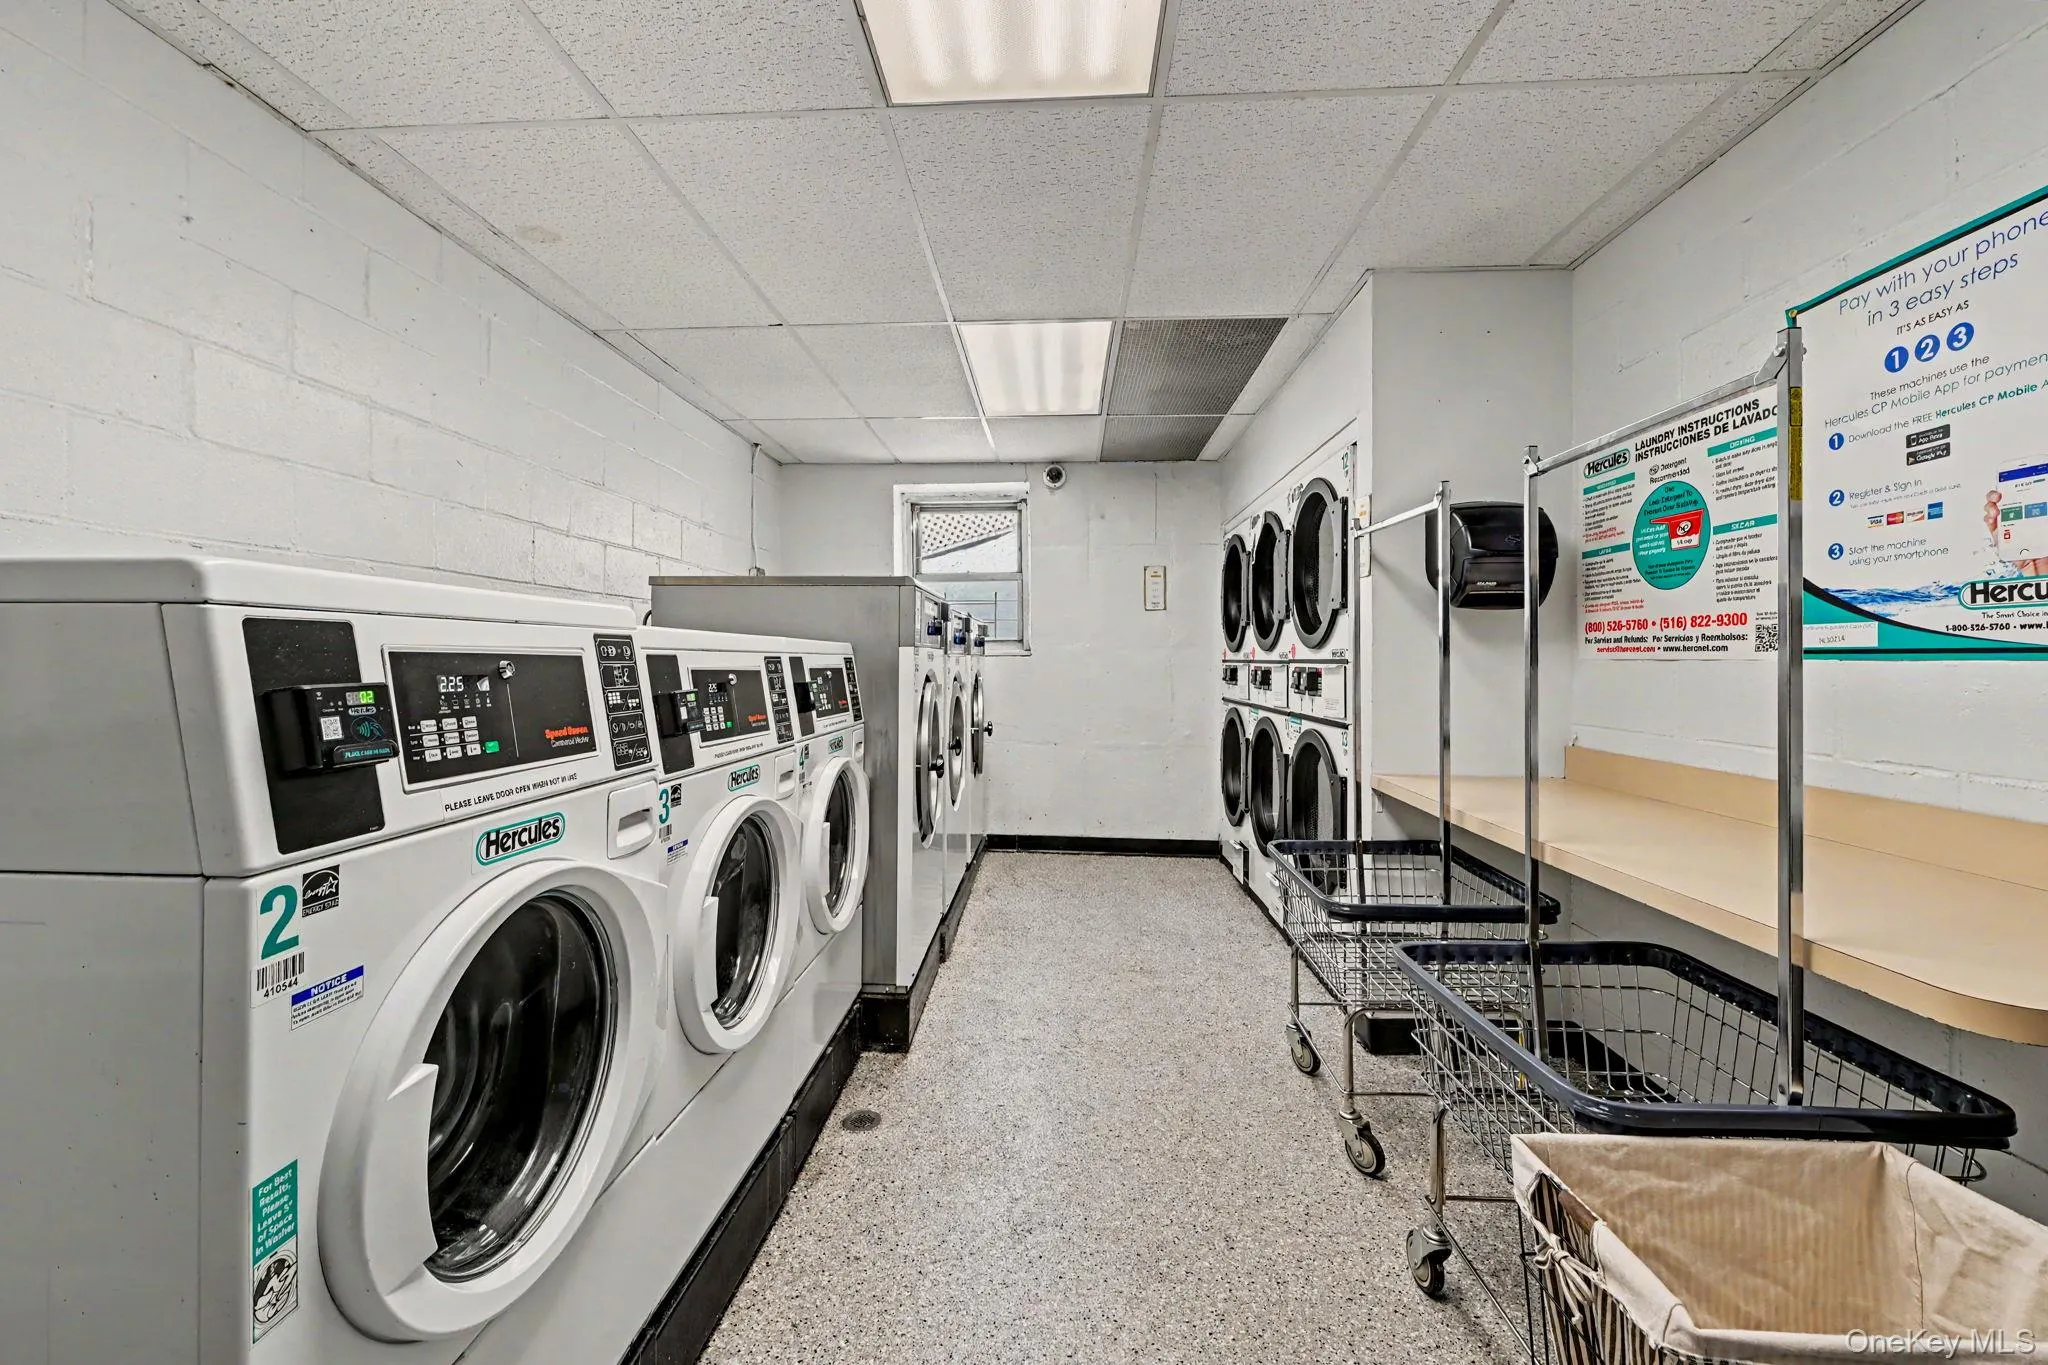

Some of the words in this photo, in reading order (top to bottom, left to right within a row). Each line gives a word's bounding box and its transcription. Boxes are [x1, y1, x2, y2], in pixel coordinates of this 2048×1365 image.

[1839, 291, 1871, 315] Pay
[1876, 271, 1916, 298] with
[1922, 247, 1968, 283] your
[1976, 210, 2048, 261] phone
[1867, 310, 1883, 326] in
[1889, 300, 1900, 318] 3
[1906, 280, 1954, 310] easy
[1960, 253, 2018, 289] steps
[1896, 323, 1912, 336] IT'S
[1913, 317, 1926, 329] AS
[1928, 305, 1954, 323] EASY
[1955, 300, 1970, 313] AS
[1891, 351, 1900, 369] 1
[1920, 339, 1934, 360] 2
[1953, 326, 1967, 348] 3
[1870, 385, 1897, 401] These
[1899, 369, 1948, 391] machines
[1949, 363, 1968, 375] use
[1971, 355, 1990, 369] the
[1824, 406, 1869, 429] Hercules
[1871, 401, 1888, 416] CP
[1890, 386, 1931, 409] Mobile
[1934, 378, 1960, 397] App
[1963, 372, 1981, 387] for
[1634, 429, 1675, 452] LAUNDRY
[1677, 399, 1760, 435] INSTRUCTIONS
[1848, 424, 1892, 444] Download
[1894, 418, 1909, 430] the
[1911, 412, 1933, 426] FREE
[1935, 401, 1976, 419] Hercules
[1979, 393, 1995, 406] CP
[1997, 383, 2038, 401] Mobile
[1635, 430, 1711, 463] INSTRUCCIONES
[1713, 421, 1729, 436] DE
[1832, 435, 1839, 449] 1
[1587, 451, 1628, 476] Hercules
[1832, 491, 1841, 505] 2
[1849, 487, 1882, 500] Register
[1885, 485, 1891, 493] &
[1893, 482, 1912, 492] Sign
[1831, 544, 1841, 559] 3
[1848, 556, 1871, 566] using
[1873, 553, 1893, 565] your
[1894, 547, 1949, 561] smartphone
[1849, 545, 1868, 556] Start
[1870, 544, 1885, 553] the
[1886, 538, 1927, 550] machine
[1585, 621, 1605, 635] (800)
[1606, 618, 1649, 632] 526-5760
[1659, 616, 1687, 632] (516)
[1690, 612, 1748, 628] 822-9300
[1982, 611, 1994, 619] The
[1996, 611, 2015, 619] Smart
[2017, 610, 2040, 618] Choice
[1664, 634, 1693, 643] Servicios
[1945, 623, 2011, 632] 1-800-526-5760
[1662, 644, 1729, 653] www.hercnet.com
[359, 690, 375, 704] 02
[730, 765, 760, 788] Hercules
[444, 798, 472, 813] PLEASE
[474, 793, 495, 805] LEAVE
[495, 788, 514, 799] DOOR
[515, 784, 531, 795] OPEN
[658, 788, 670, 824] 3
[485, 817, 560, 859] Hercules
[259, 884, 300, 961] 2
[263, 977, 299, 999] 410544
[310, 973, 348, 997] NOTICE
[258, 1183, 273, 1198] For
[274, 1168, 293, 1187] Best
[262, 1194, 289, 1218] Please
[257, 1211, 282, 1233] Leave
[257, 1230, 267, 1243] of
[268, 1213, 293, 1238] Space
[265, 1222, 296, 1248] Washer
